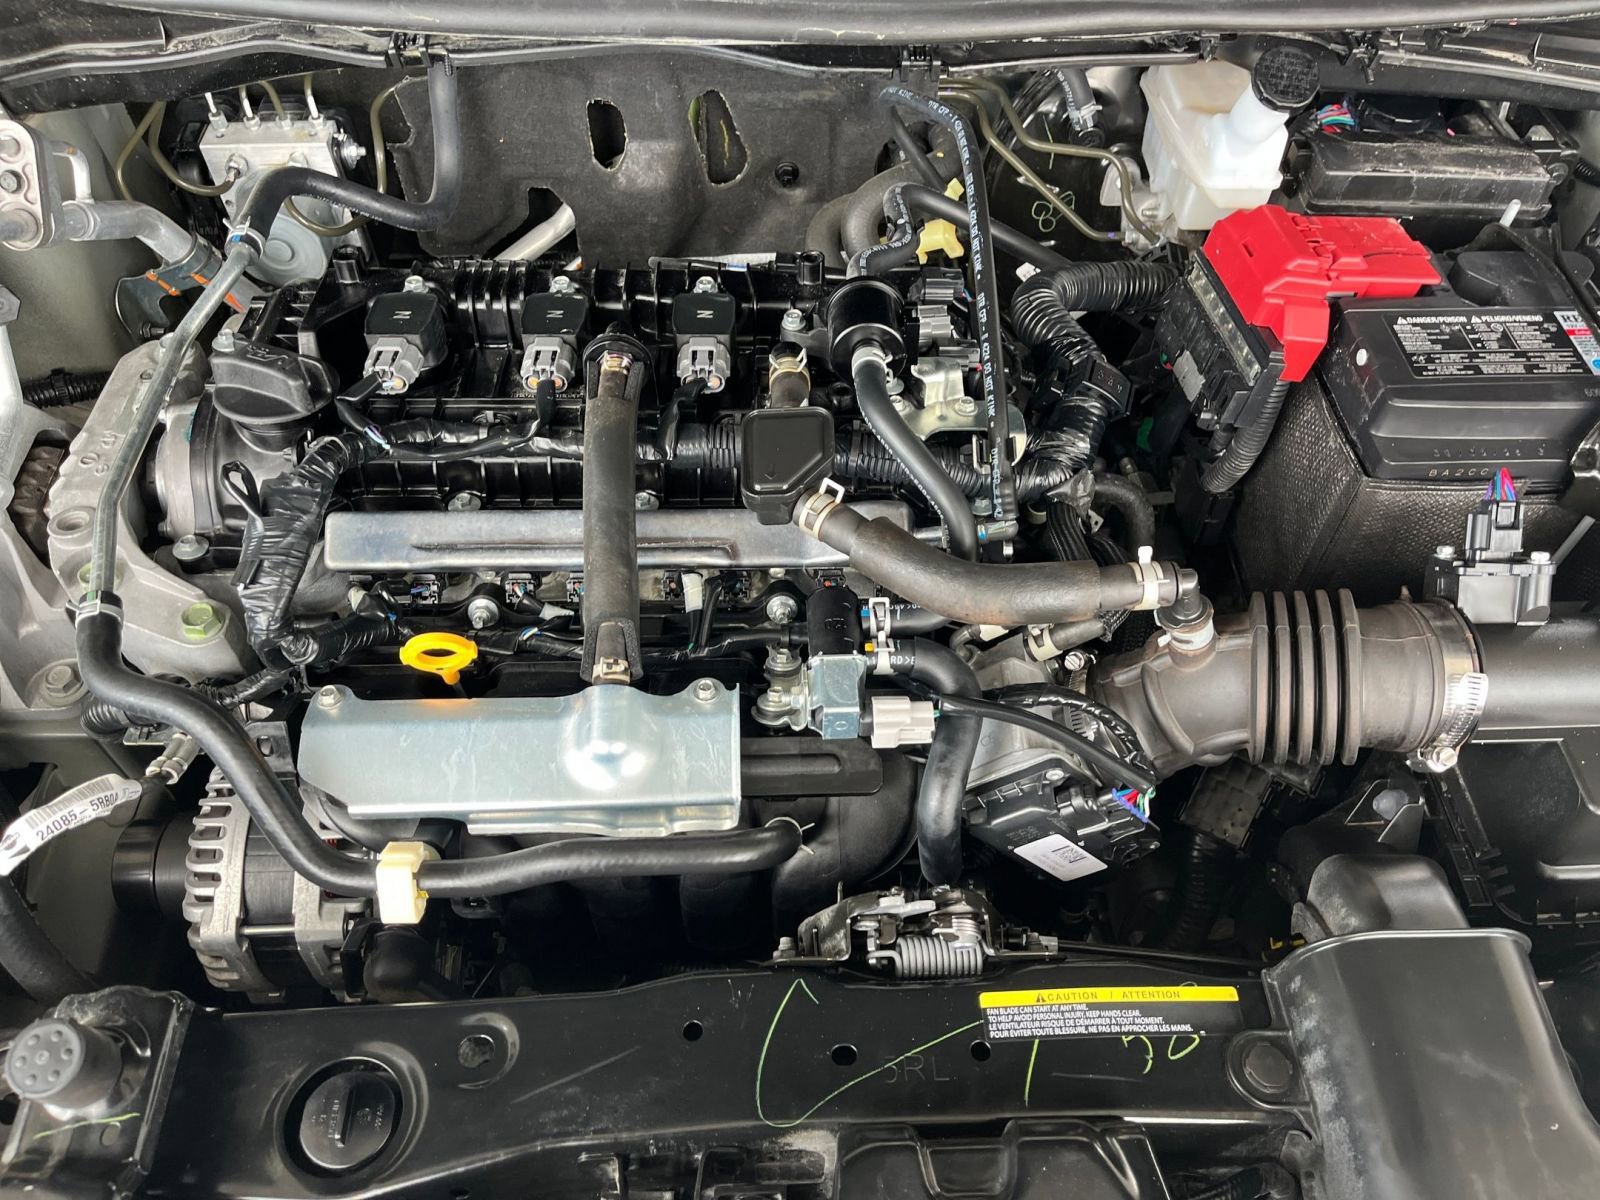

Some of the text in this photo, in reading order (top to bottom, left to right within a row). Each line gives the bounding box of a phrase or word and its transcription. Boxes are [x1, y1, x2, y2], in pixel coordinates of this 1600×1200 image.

[1047, 991, 1098, 1001] CAUTION
[1122, 990, 1181, 999] ATTENTION
[1033, 1005, 1051, 1013] START
[1052, 1004, 1059, 1012] AT
[1033, 1012, 1063, 1020] PERSONAL
[1086, 1010, 1100, 1018] KEEP
[998, 1021, 1041, 1030] VENTILATEUR
[1041, 1020, 1065, 1028] RISQUE
[1077, 1017, 1110, 1025] DÉMARRER
[1032, 1028, 1054, 1036] TOUTE
[1099, 1025, 1111, 1033] PAS
[1121, 1024, 1159, 1032] APPROCHER
[1170, 1023, 1194, 1031] MAINS.
